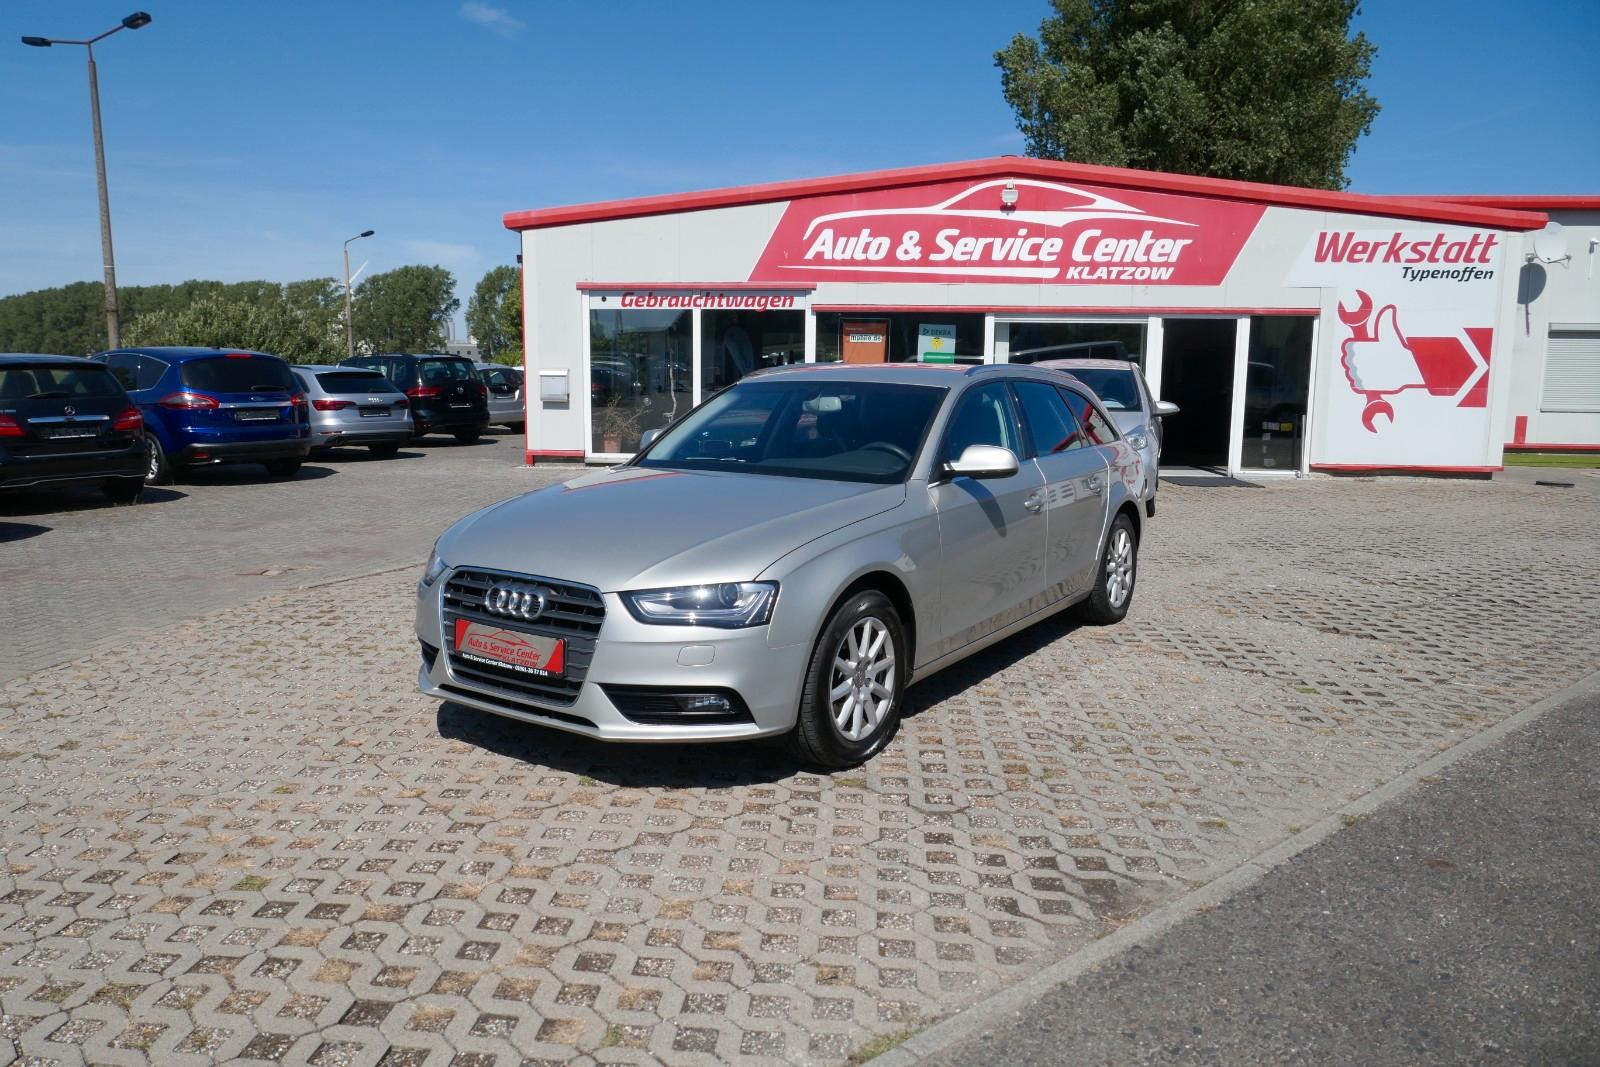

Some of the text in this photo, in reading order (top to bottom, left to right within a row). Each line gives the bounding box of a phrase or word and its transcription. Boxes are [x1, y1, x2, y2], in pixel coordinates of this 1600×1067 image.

[804, 228, 1194, 263] Auto & Service Center
[1314, 231, 1499, 264] Werkstatt
[1066, 266, 1175, 281] KLATZOW
[1401, 266, 1494, 282] Typenoffen
[620, 291, 795, 312] Gebrauchtwagen
[468, 637, 482, 648] Auto
[490, 642, 515, 655] Service
[516, 648, 541, 660] Center
[501, 654, 538, 668] KLATZOW
